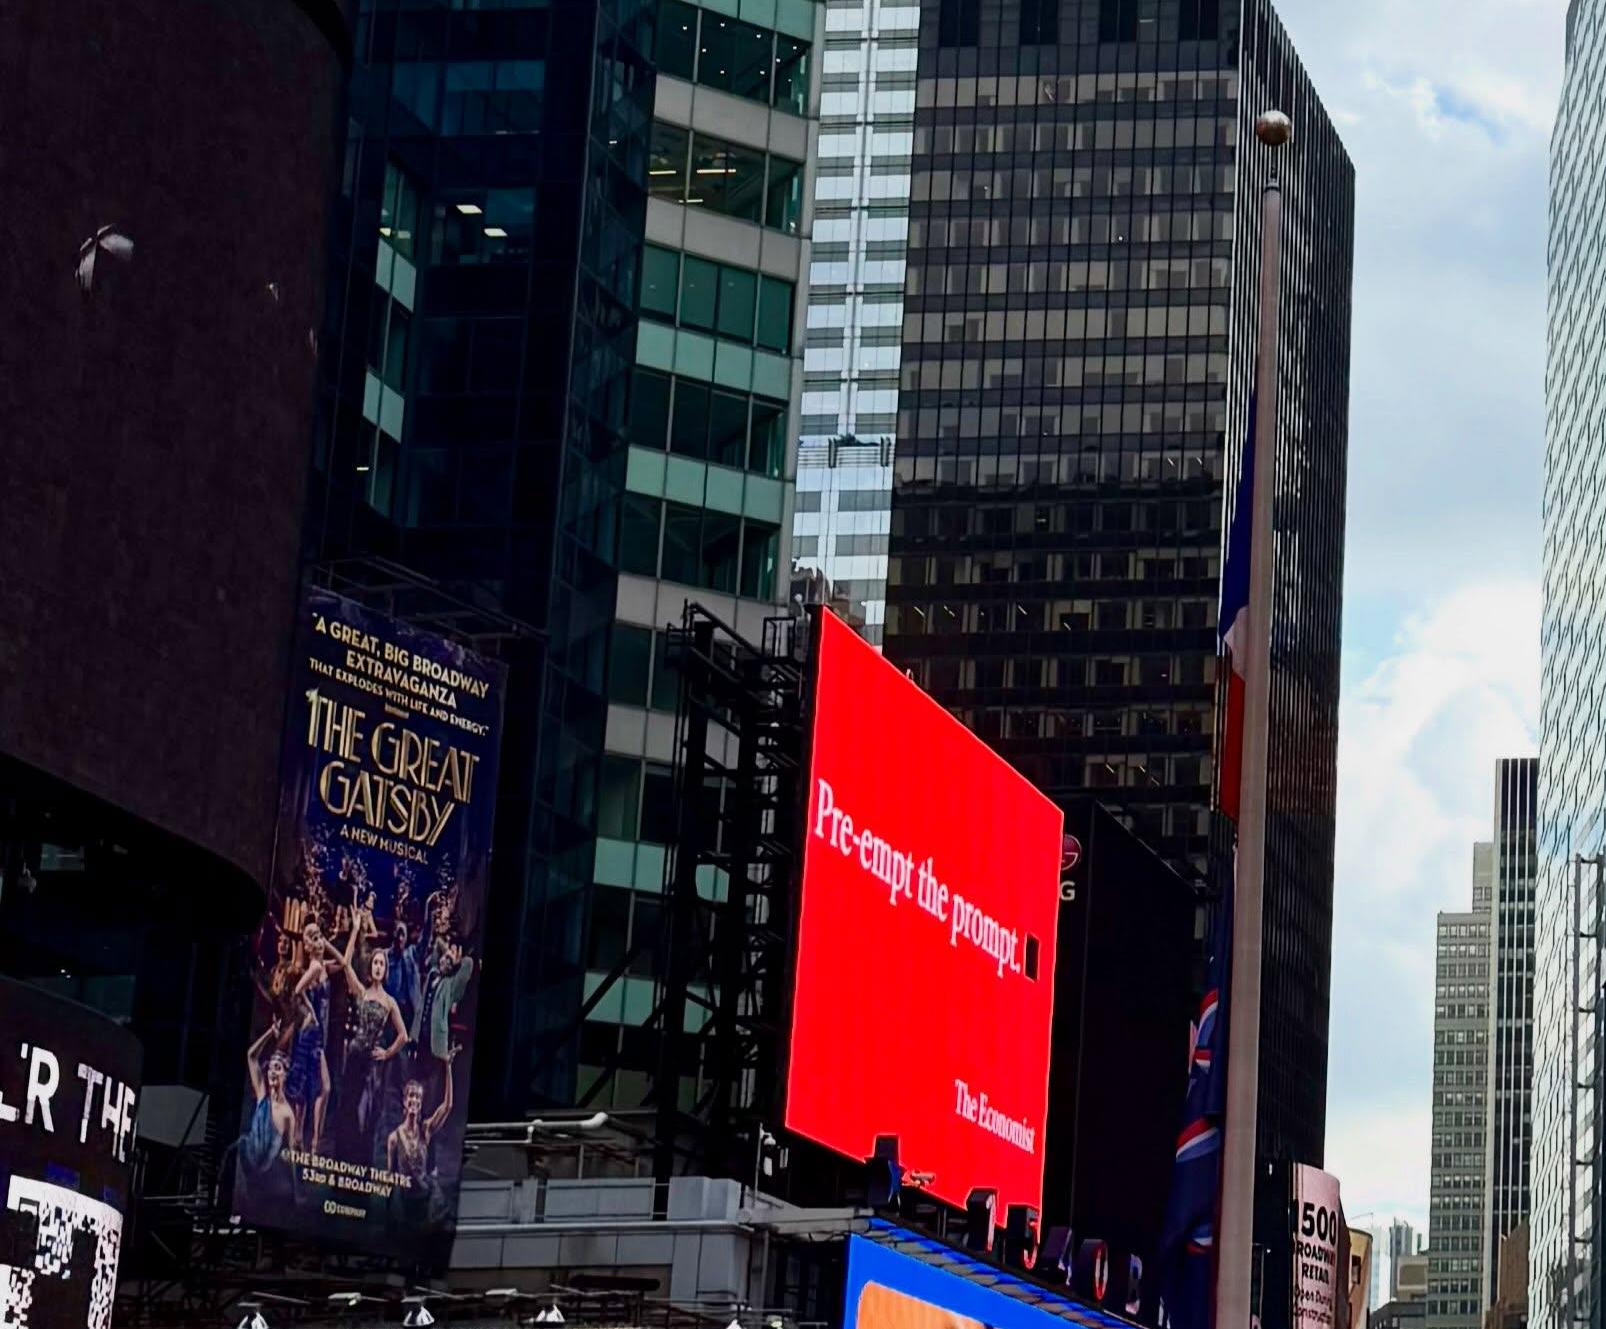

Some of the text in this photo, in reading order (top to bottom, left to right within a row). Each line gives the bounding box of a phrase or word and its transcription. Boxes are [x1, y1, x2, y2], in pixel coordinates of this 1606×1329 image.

[309, 657, 333, 677] THAT
[335, 668, 383, 696] EXPLODES
[385, 687, 409, 707] WITH
[410, 697, 428, 714] LIFE
[430, 706, 449, 722] AND
[330, 622, 381, 657] GREAT,
[384, 642, 409, 667] BIG
[413, 654, 490, 699] BROADWAY
[346, 650, 458, 709] EXTRAVAGANZA
[305, 687, 480, 804] THE GREAT
[319, 760, 455, 847] GATSBY
[340, 824, 428, 865] A NEW MUSICAL
[814, 777, 1021, 978] Pre-empt the prompt.
[1060, 879, 1076, 902] G
[954, 1078, 1035, 1155] The Economist
[311, 1154, 368, 1178] BROADWAY
[370, 1167, 412, 1188] THEATRE
[338, 1177, 392, 1198] BROADWAY
